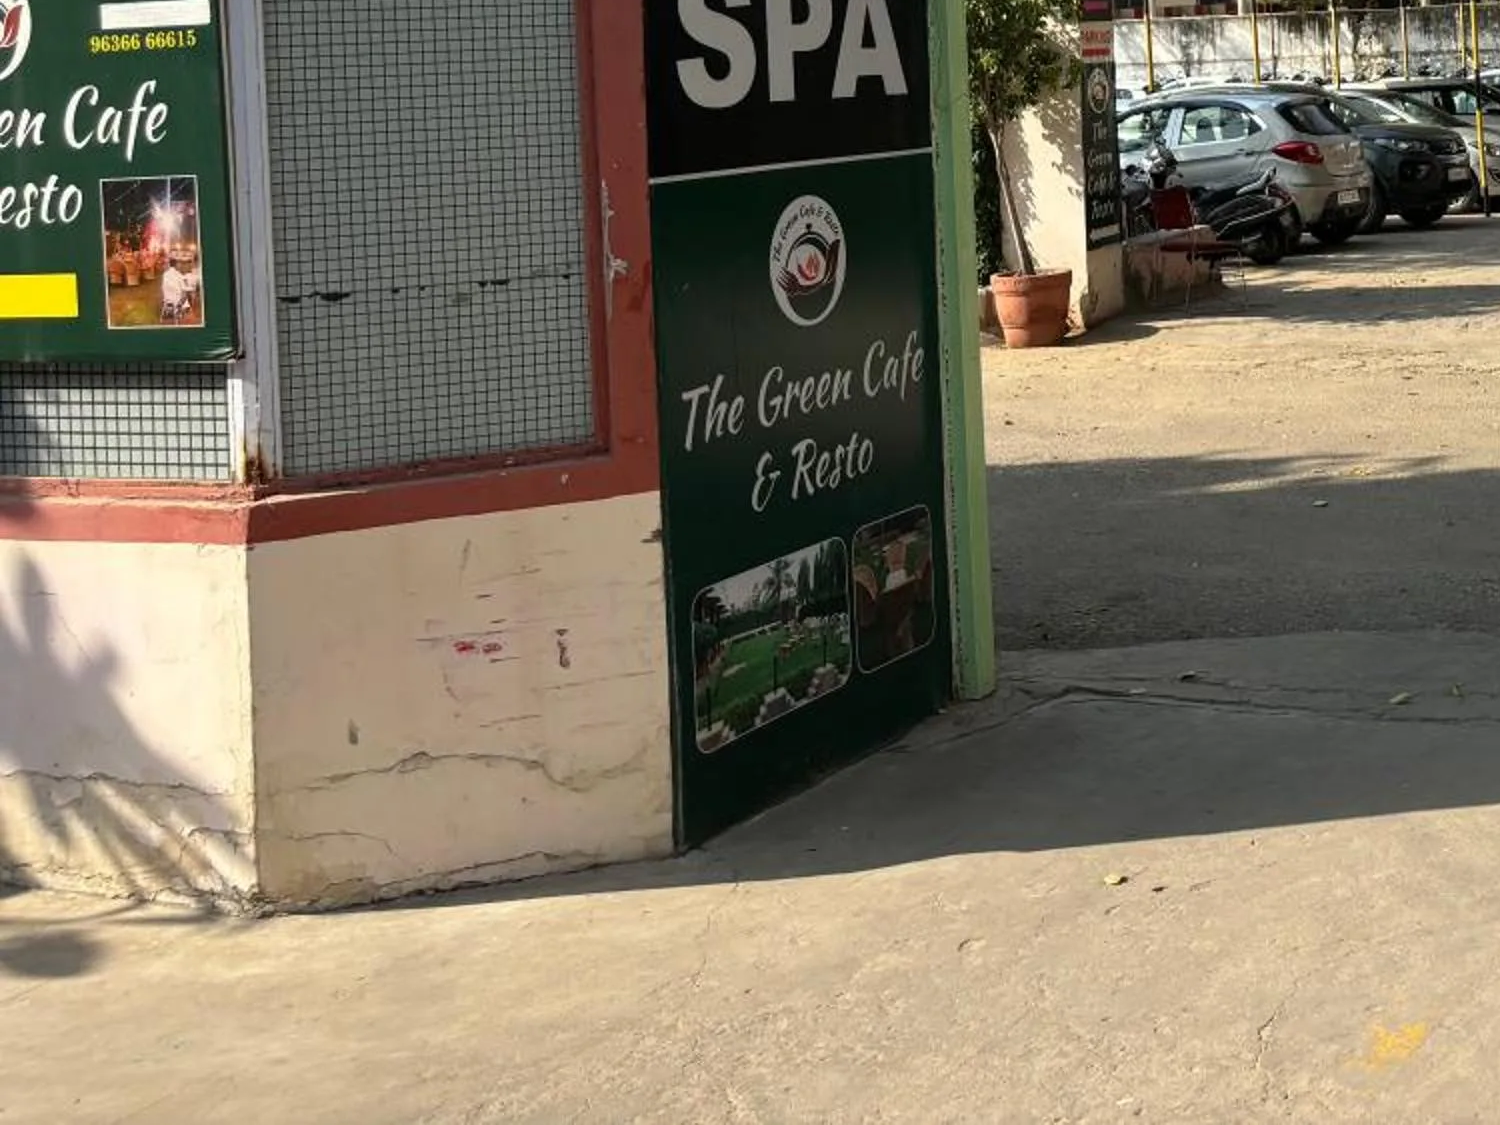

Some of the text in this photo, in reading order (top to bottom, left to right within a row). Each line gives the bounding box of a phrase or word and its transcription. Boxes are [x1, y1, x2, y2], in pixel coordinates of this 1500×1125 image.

[89, 29, 197, 53] 96366 66615
[63, 79, 169, 162] Cafe
[682, 330, 925, 452] The Green Cafe
[751, 432, 874, 513] & Resto
